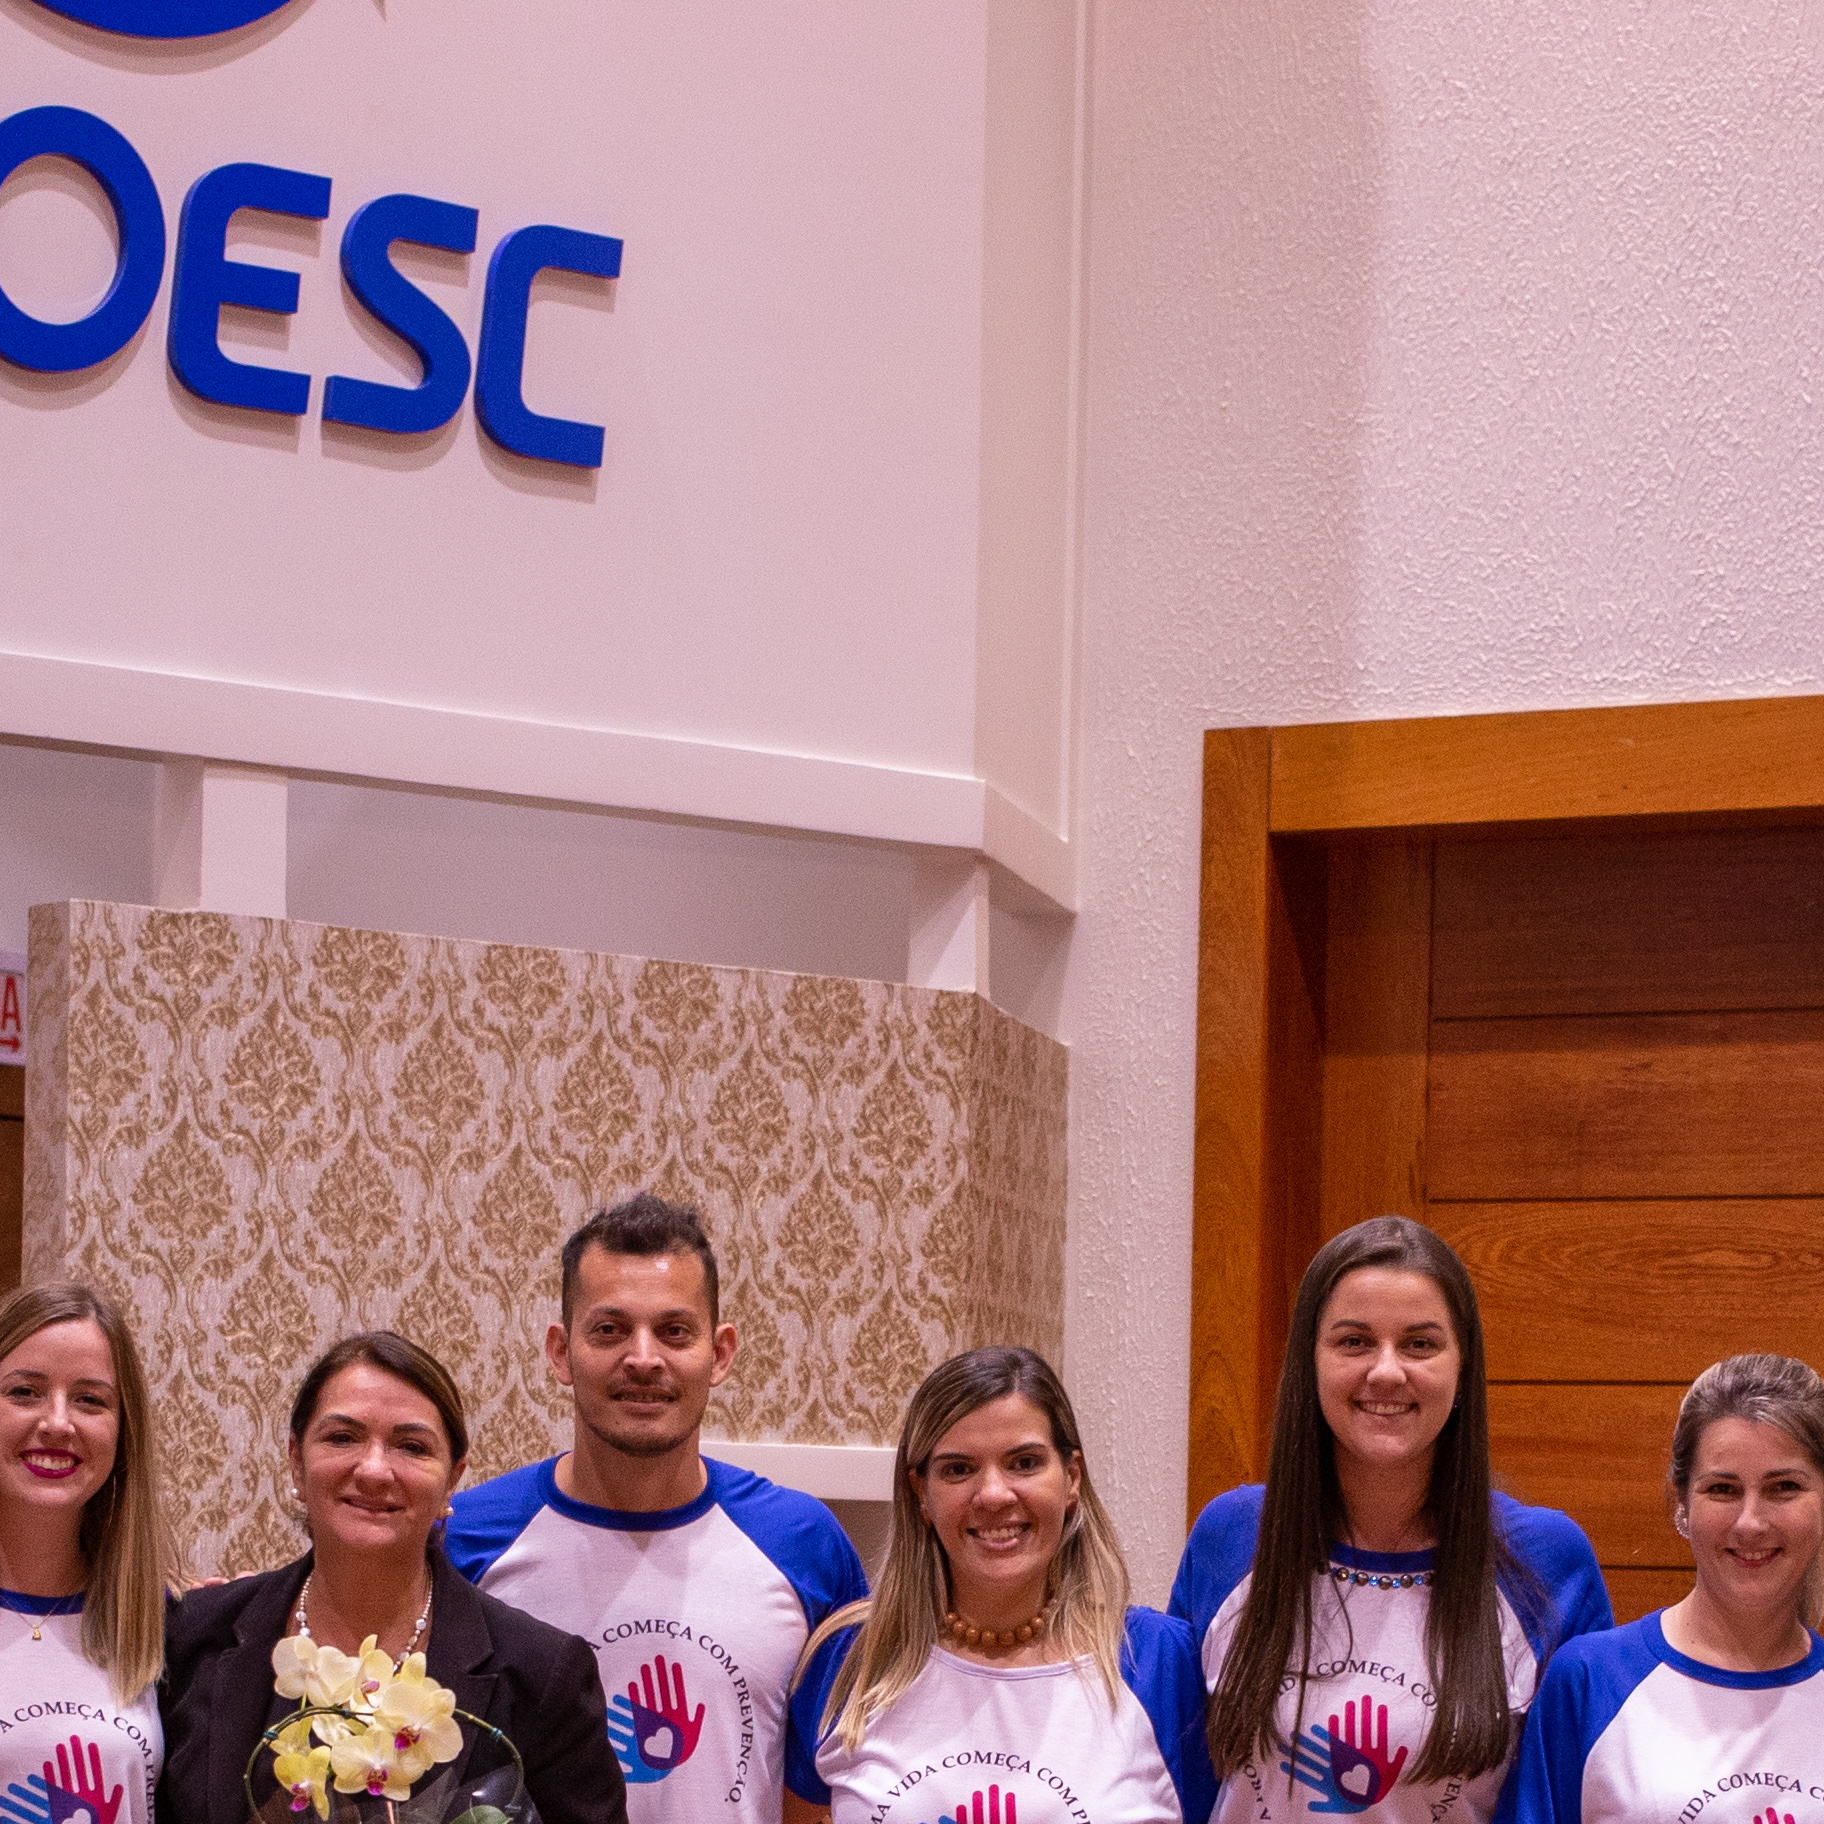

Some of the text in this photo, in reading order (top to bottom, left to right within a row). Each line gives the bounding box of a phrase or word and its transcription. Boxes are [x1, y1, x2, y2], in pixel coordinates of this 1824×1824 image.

[602, 1619, 693, 1644] COMEÇA
[698, 1634, 739, 1678] COM
[1316, 1658, 1407, 1689] COMEÇA
[1410, 1682, 1438, 1712] CO
[14, 1701, 107, 1722] COMEÇA
[113, 1715, 152, 1760] COM
[886, 1764, 938, 1798] VIDA
[941, 1751, 1032, 1773] COMEÇA
[1036, 1766, 1079, 1807] COM
[1717, 1772, 1803, 1793] COMEÇA
